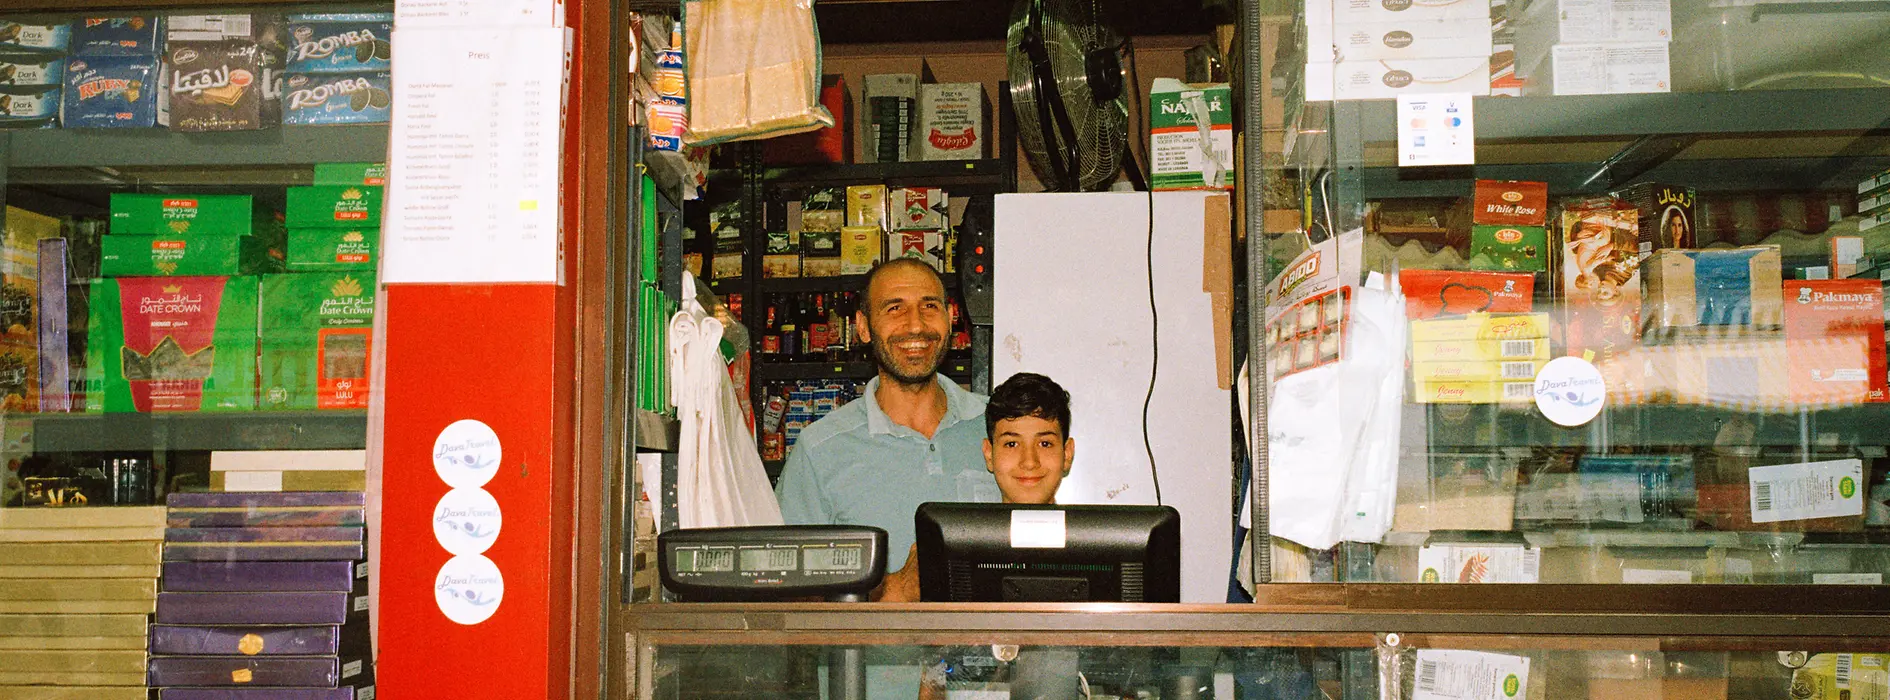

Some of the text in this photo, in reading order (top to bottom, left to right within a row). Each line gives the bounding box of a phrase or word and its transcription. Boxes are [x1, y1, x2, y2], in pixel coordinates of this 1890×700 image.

[23, 31, 43, 39] Dark
[294, 29, 376, 61] ROMBA
[468, 51, 490, 60] Preis
[78, 79, 131, 100] RUBY
[286, 77, 371, 111] ROMBA
[13, 101, 33, 109] Dark
[1486, 204, 1537, 216] White Rose
[1279, 257, 1318, 294] ABIDO
[1813, 292, 1873, 305] Pakmaya
[139, 304, 201, 314] DATE CROWN
[320, 306, 373, 315] Date Crown
[336, 381, 352, 390] لولو
[336, 391, 353, 399] LULU
[435, 437, 498, 459] Dava Travel
[436, 506, 499, 522] Dava Travel
[437, 574, 499, 590] Dava Travel
